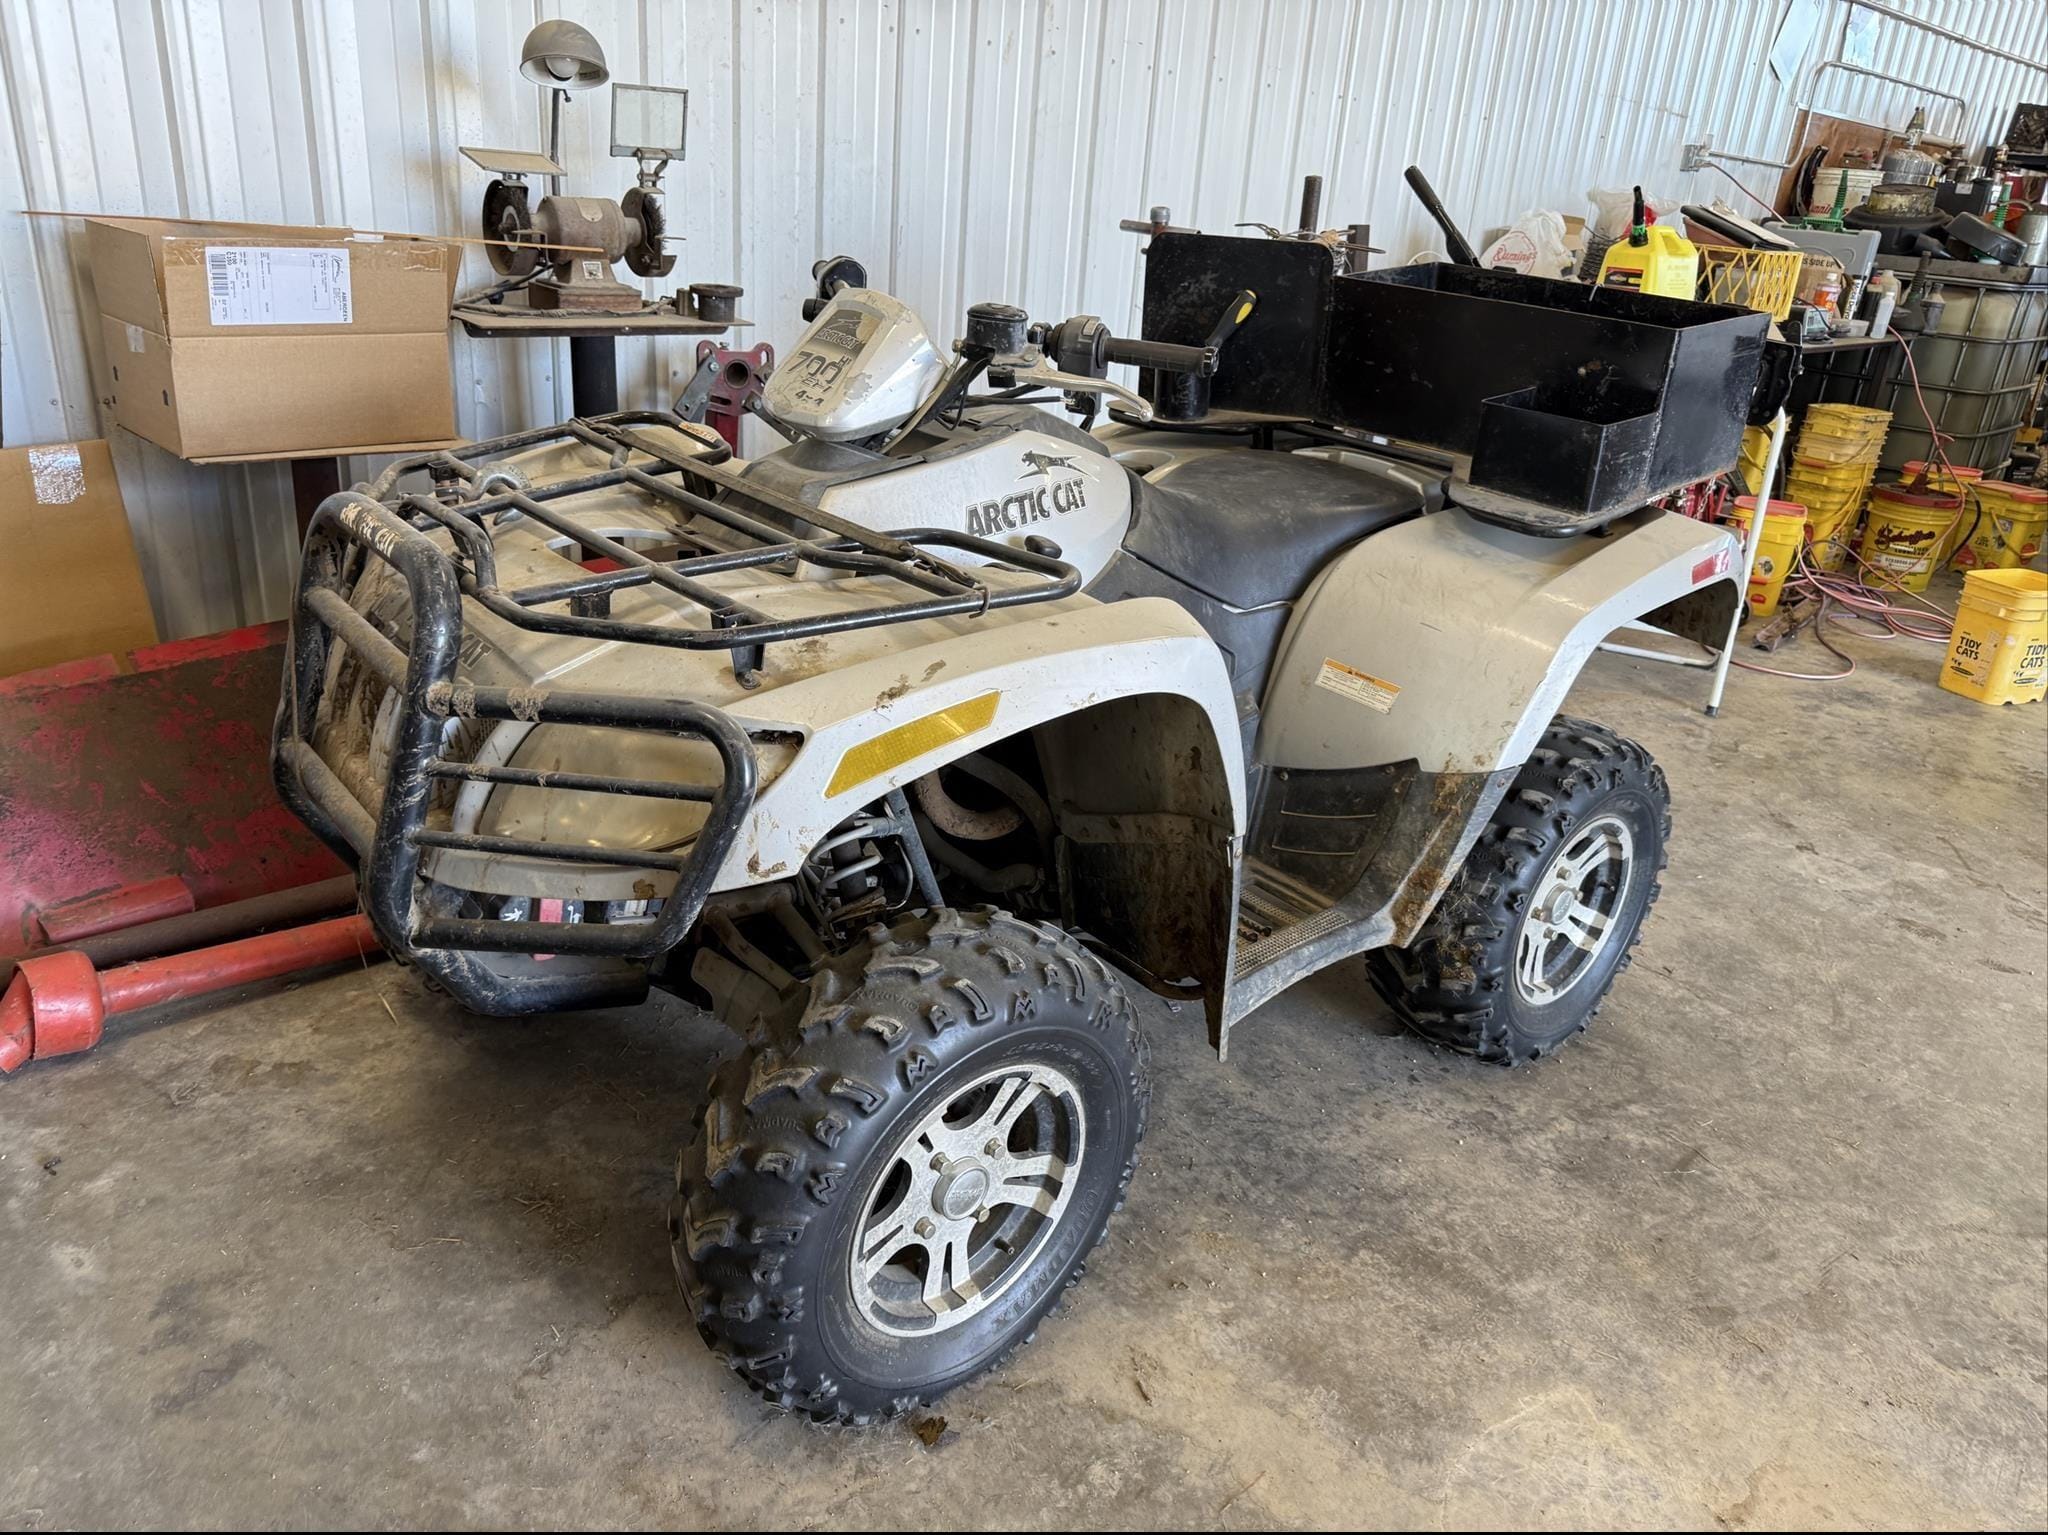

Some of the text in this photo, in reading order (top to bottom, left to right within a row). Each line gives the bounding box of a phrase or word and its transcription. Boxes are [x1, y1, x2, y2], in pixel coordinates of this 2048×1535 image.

[1808, 258, 1825, 267] SIDE
[1825, 260, 1835, 268] UP
[787, 351, 844, 385] 700
[965, 477, 1087, 538] ARCTIC CAT
[1959, 636, 1982, 650] TIDY
[1955, 645, 1980, 661] CATS
[2025, 644, 2047, 657] TIDY
[2019, 656, 2046, 669] CATS
